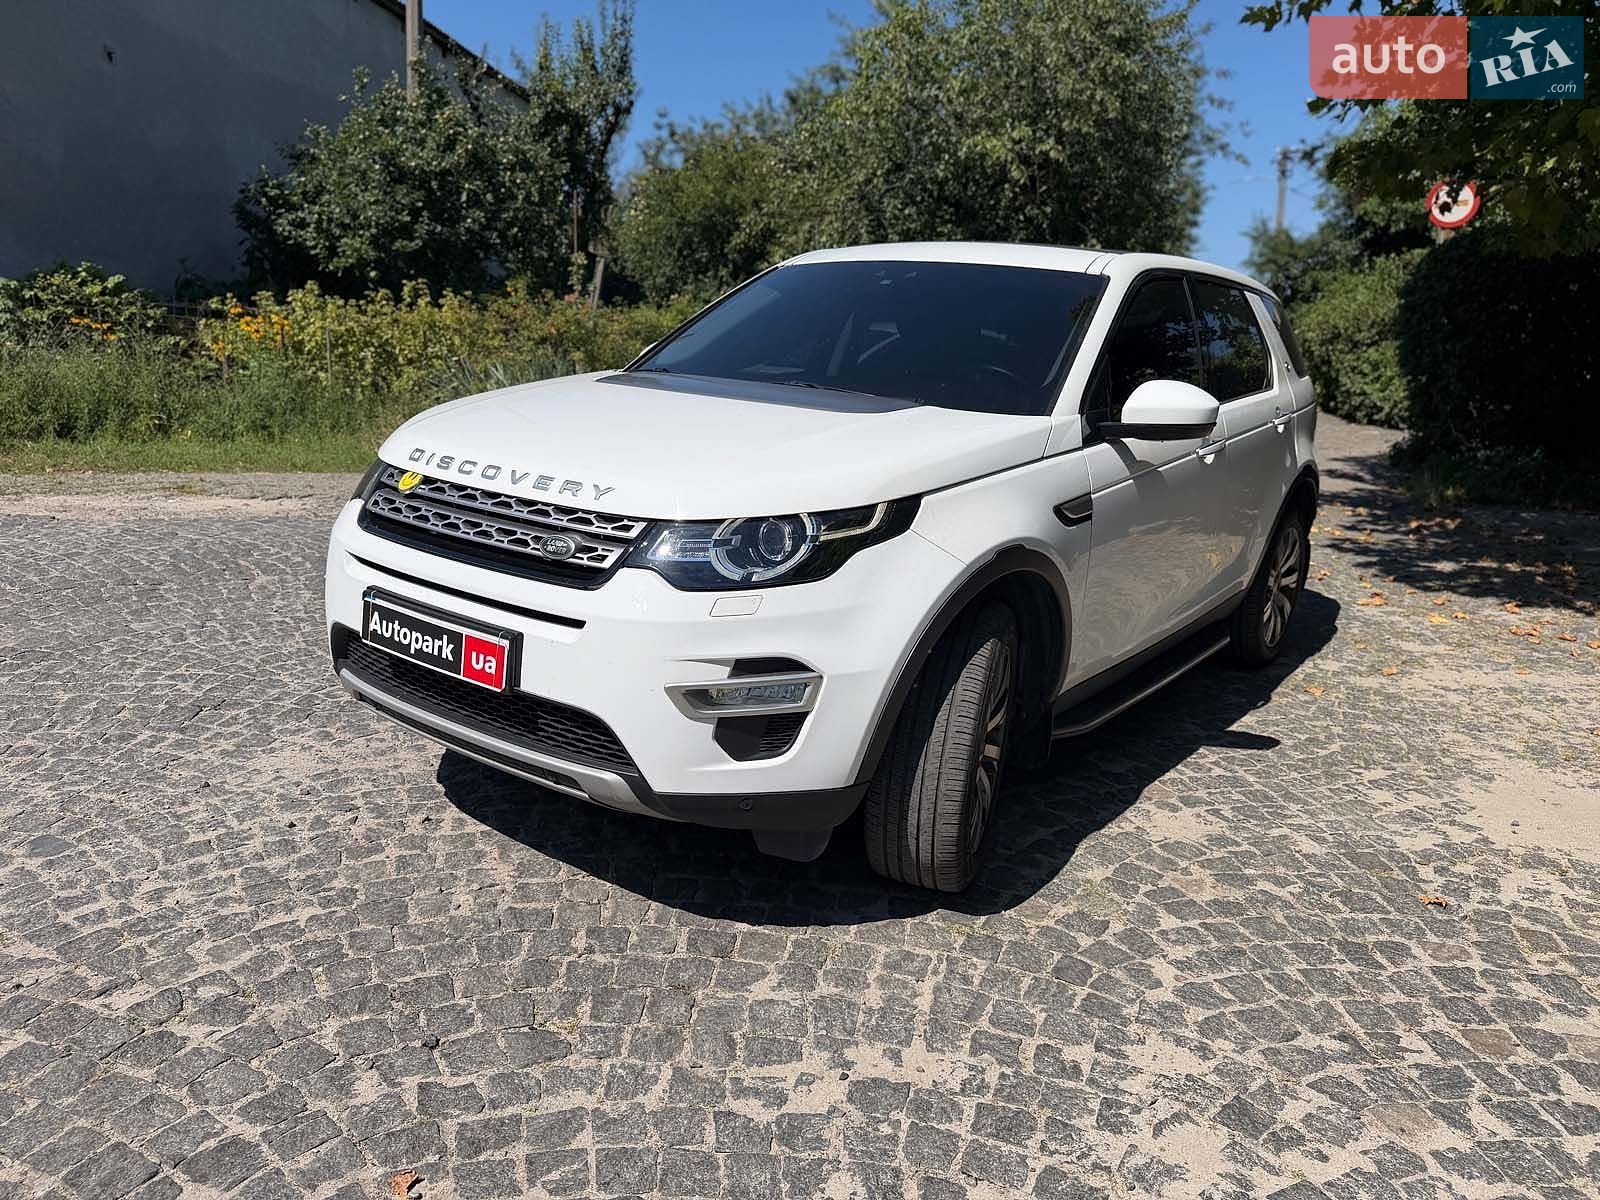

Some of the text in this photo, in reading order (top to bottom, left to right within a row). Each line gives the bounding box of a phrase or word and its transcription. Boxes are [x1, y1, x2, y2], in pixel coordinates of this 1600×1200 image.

[408, 448, 616, 501] DISCOVERY
[369, 611, 497, 675] Autopark ua
